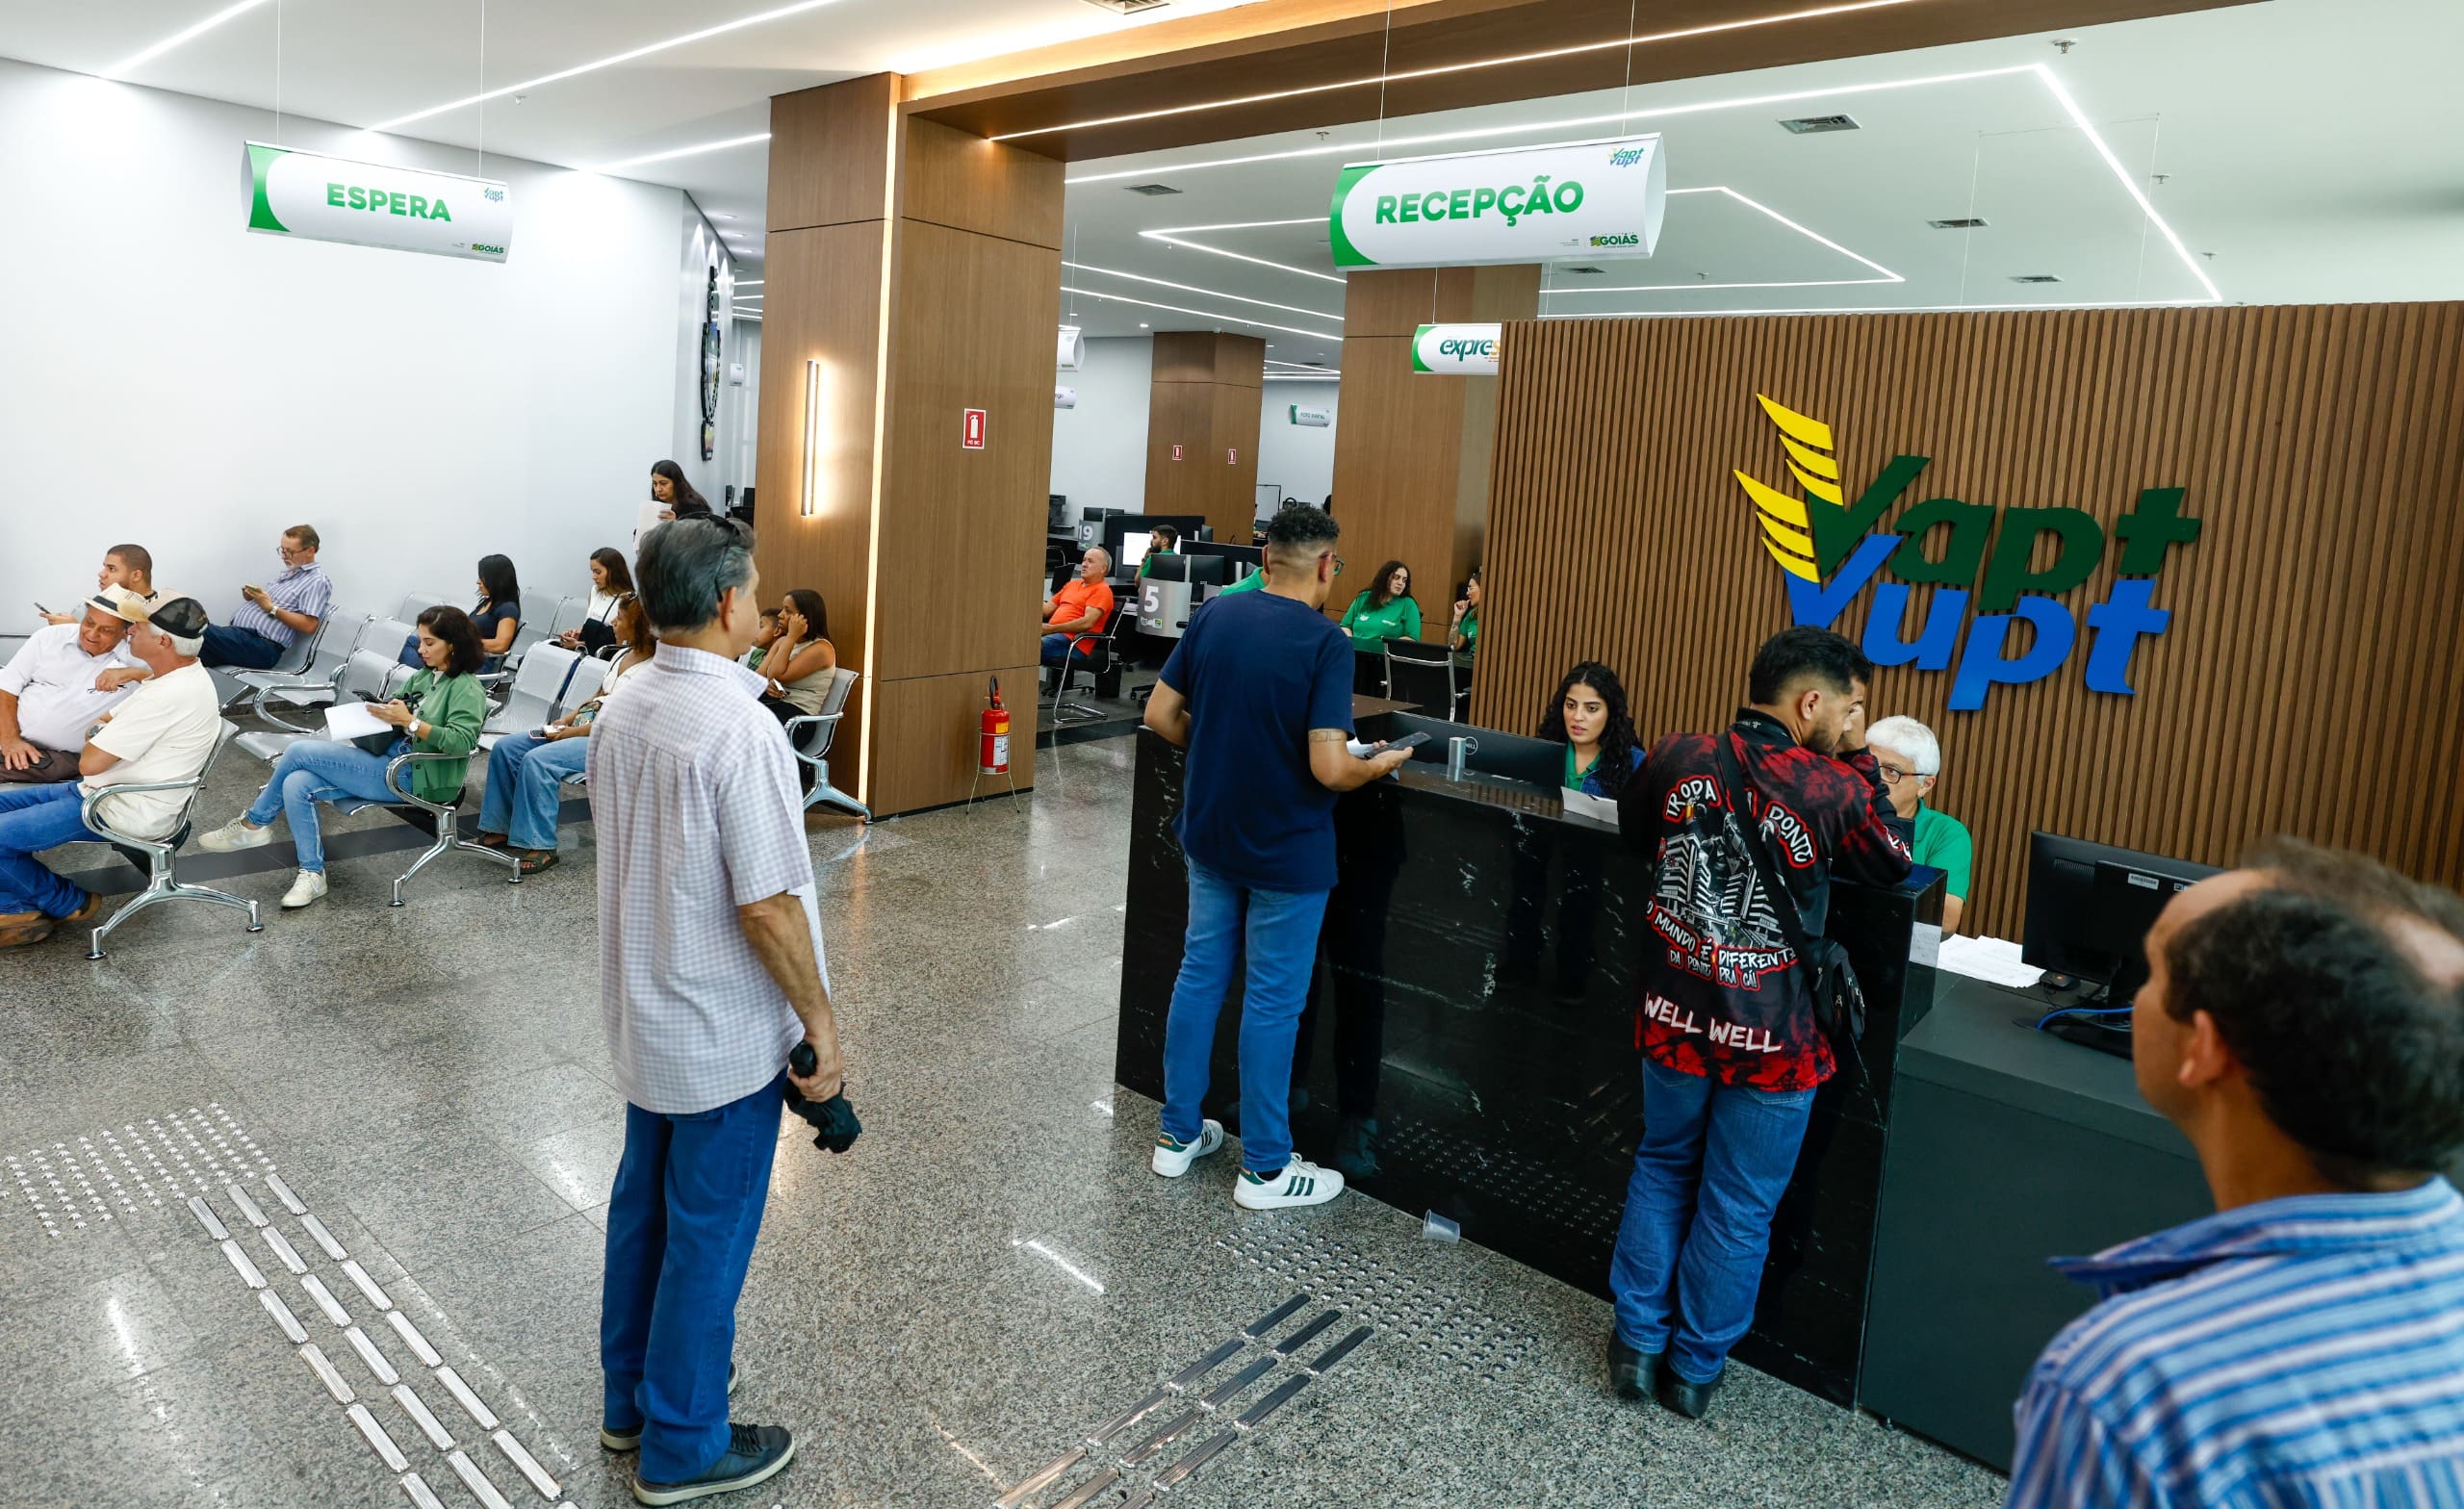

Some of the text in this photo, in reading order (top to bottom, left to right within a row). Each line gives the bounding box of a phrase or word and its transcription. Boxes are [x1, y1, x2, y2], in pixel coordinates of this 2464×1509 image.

[327, 183, 451, 222] ESPERA
[1375, 175, 1584, 227] RECEPÇÃO
[478, 243, 504, 254] GOIÁS
[1600, 233, 1639, 245] GOIÁS
[1079, 524, 1093, 541] 19
[1806, 454, 2202, 611] Vapt
[1143, 585, 1159, 613] 5
[1783, 533, 2170, 711] Vupt
[1665, 780, 1717, 817] TROPA
[1769, 806, 1813, 862] PONTE
[1655, 911, 1697, 952] MUNDO
[1701, 938, 1712, 961] É
[1670, 949, 1681, 965] DA
[1687, 954, 1712, 977] PONTE
[1719, 966, 1737, 985] PRA
[1645, 991, 1782, 1053] WELL WELL
